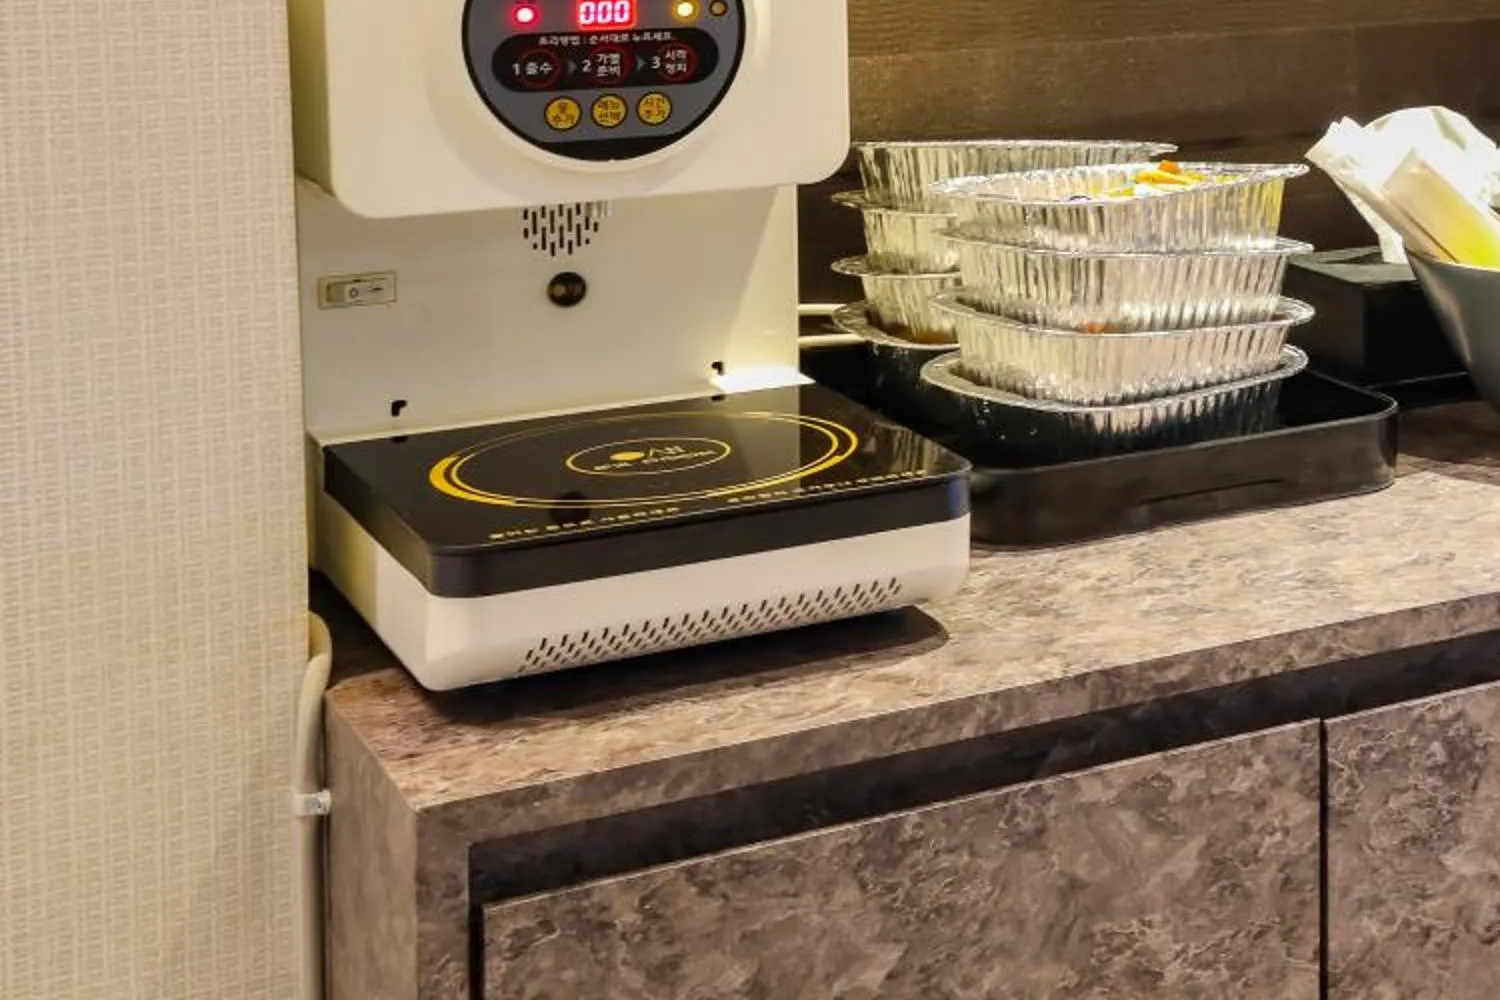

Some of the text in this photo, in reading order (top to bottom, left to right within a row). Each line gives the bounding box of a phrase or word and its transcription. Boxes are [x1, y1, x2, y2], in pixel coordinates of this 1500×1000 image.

[578, 0, 631, 25] 000
[512, 63, 520, 76] 1
[582, 59, 592, 73] 2
[651, 57, 661, 70] 3
